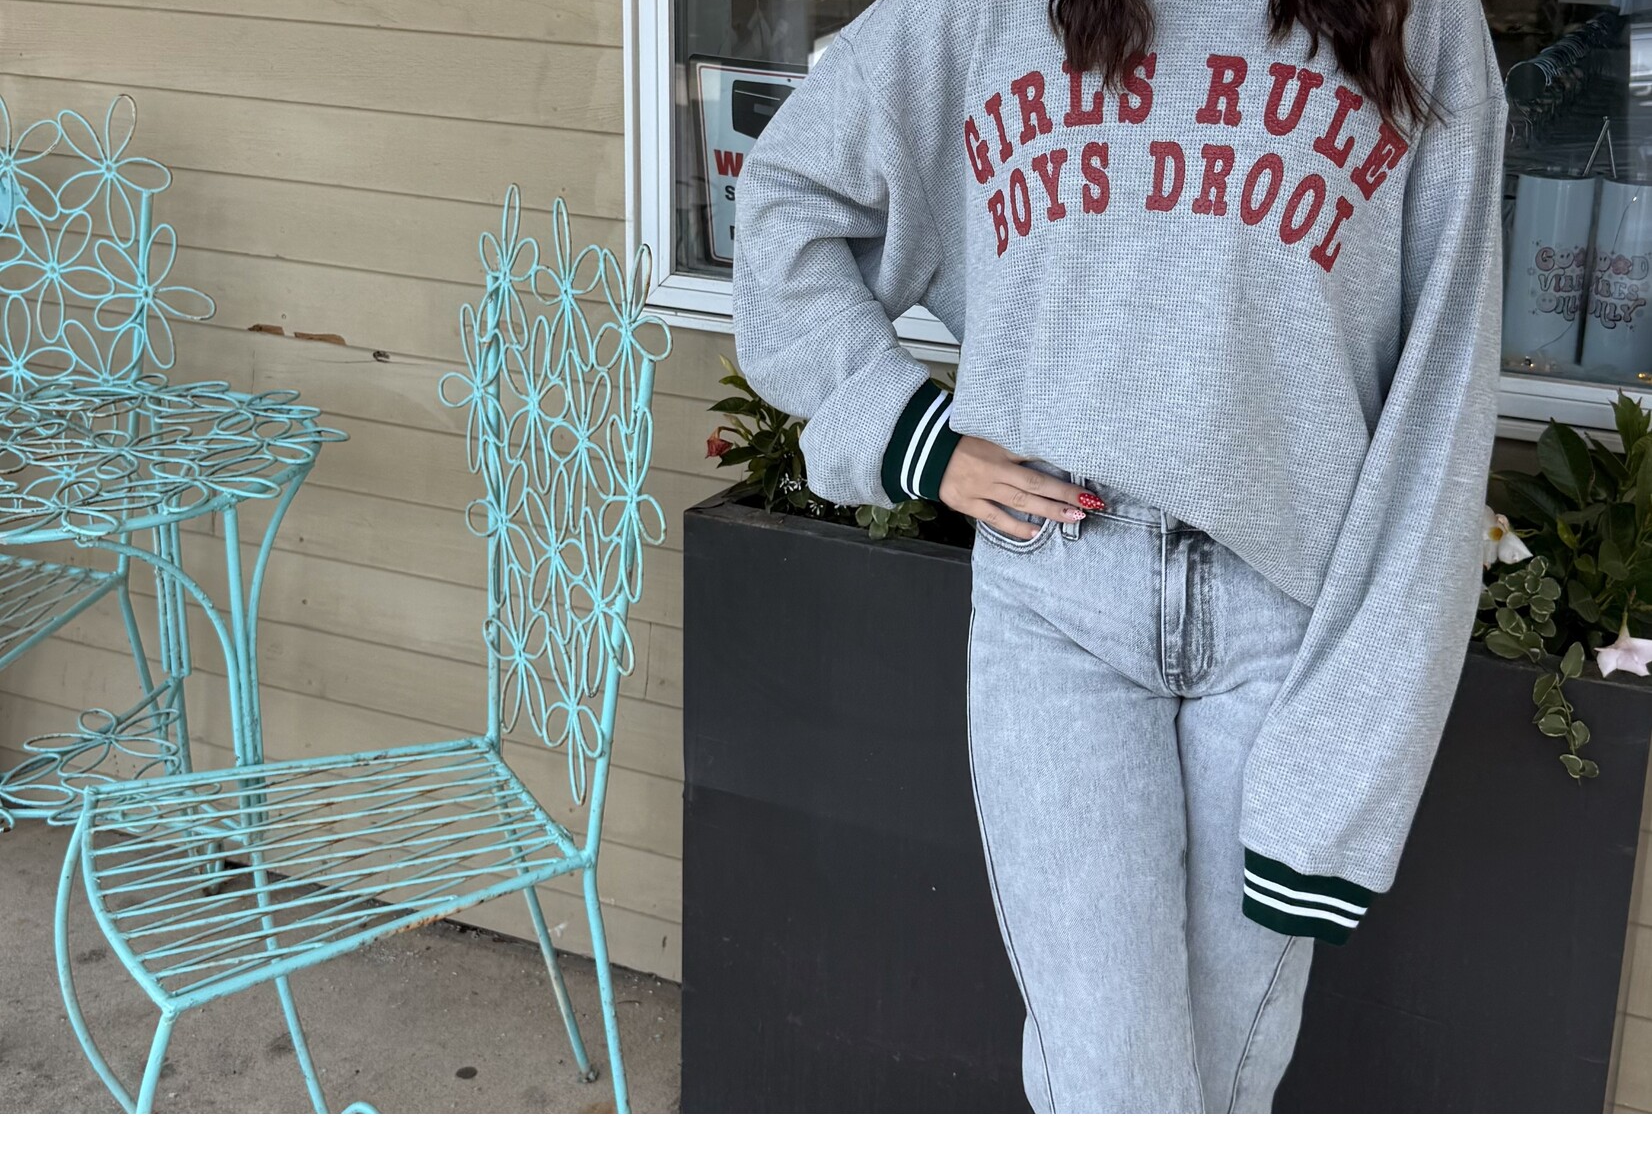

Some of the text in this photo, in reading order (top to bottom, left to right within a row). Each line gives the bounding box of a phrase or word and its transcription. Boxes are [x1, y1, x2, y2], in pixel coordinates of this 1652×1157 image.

[964, 52, 1409, 200] GIRLS RULE
[987, 140, 1354, 273] BOYS DROOL
